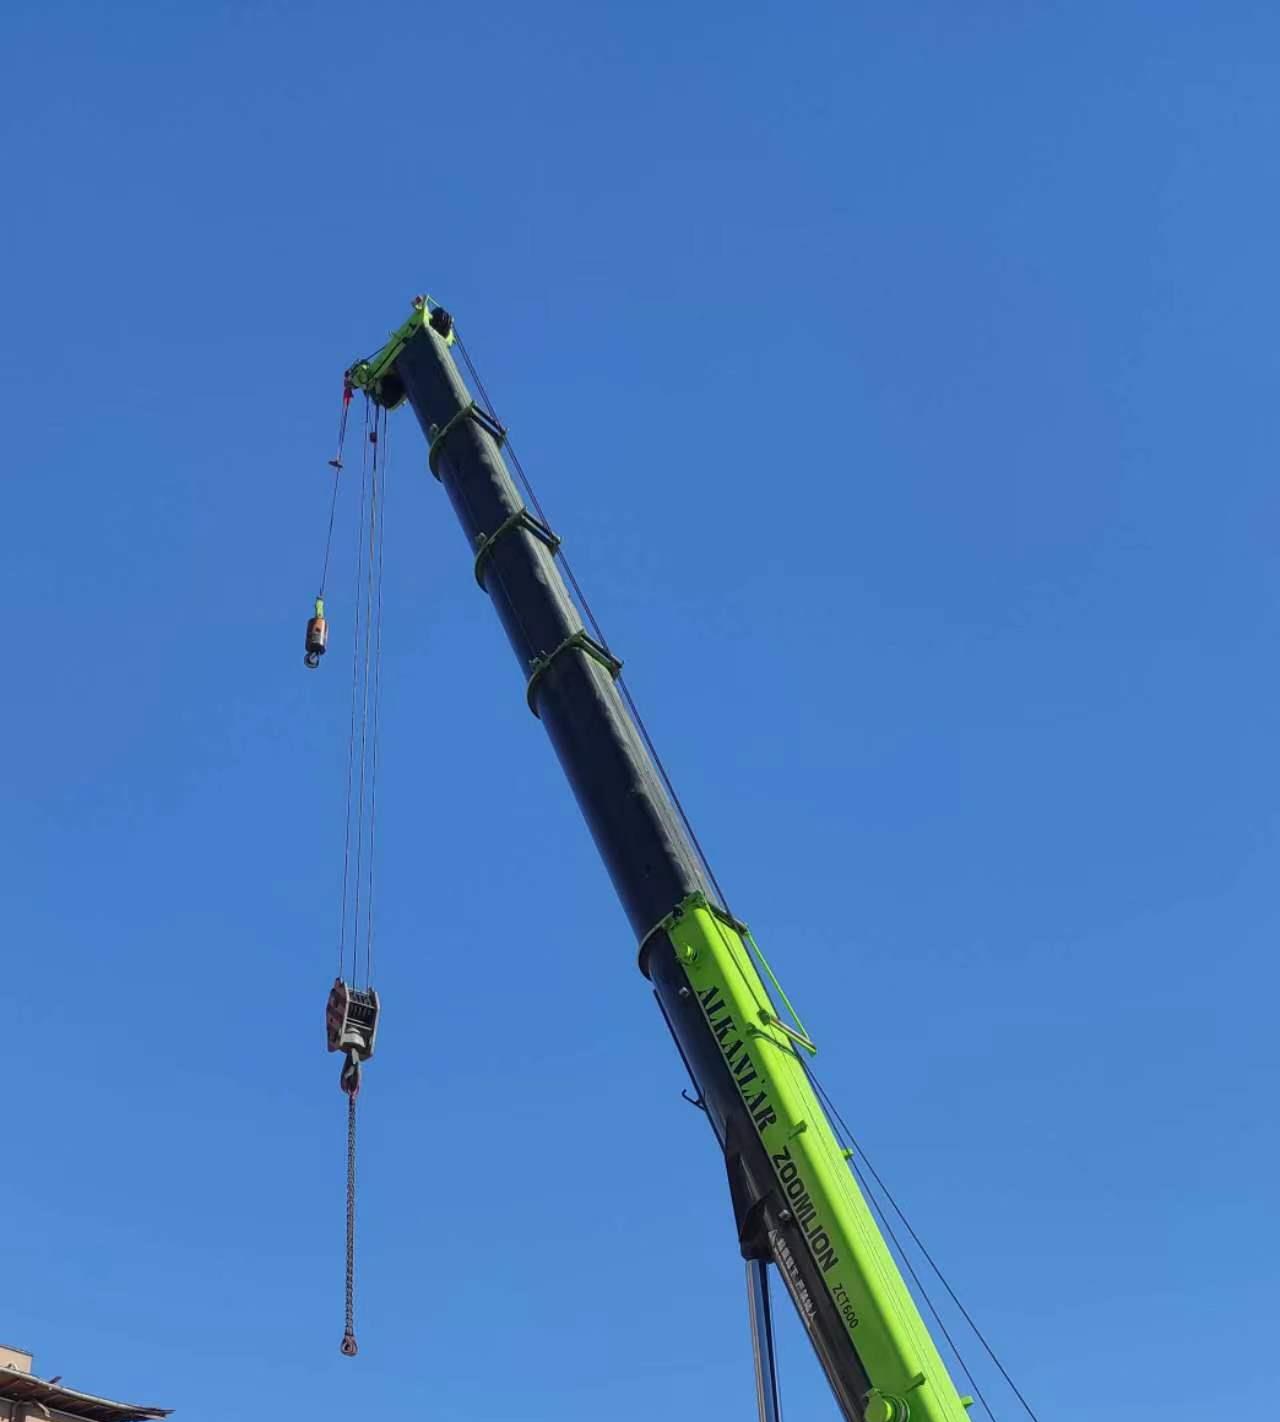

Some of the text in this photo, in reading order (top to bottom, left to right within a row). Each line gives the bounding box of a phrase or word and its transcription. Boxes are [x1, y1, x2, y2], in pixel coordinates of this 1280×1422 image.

[696, 985, 777, 1133] ALKANLAR
[771, 1146, 839, 1273] ZOOMLION
[832, 1282, 859, 1329] ZCT600
